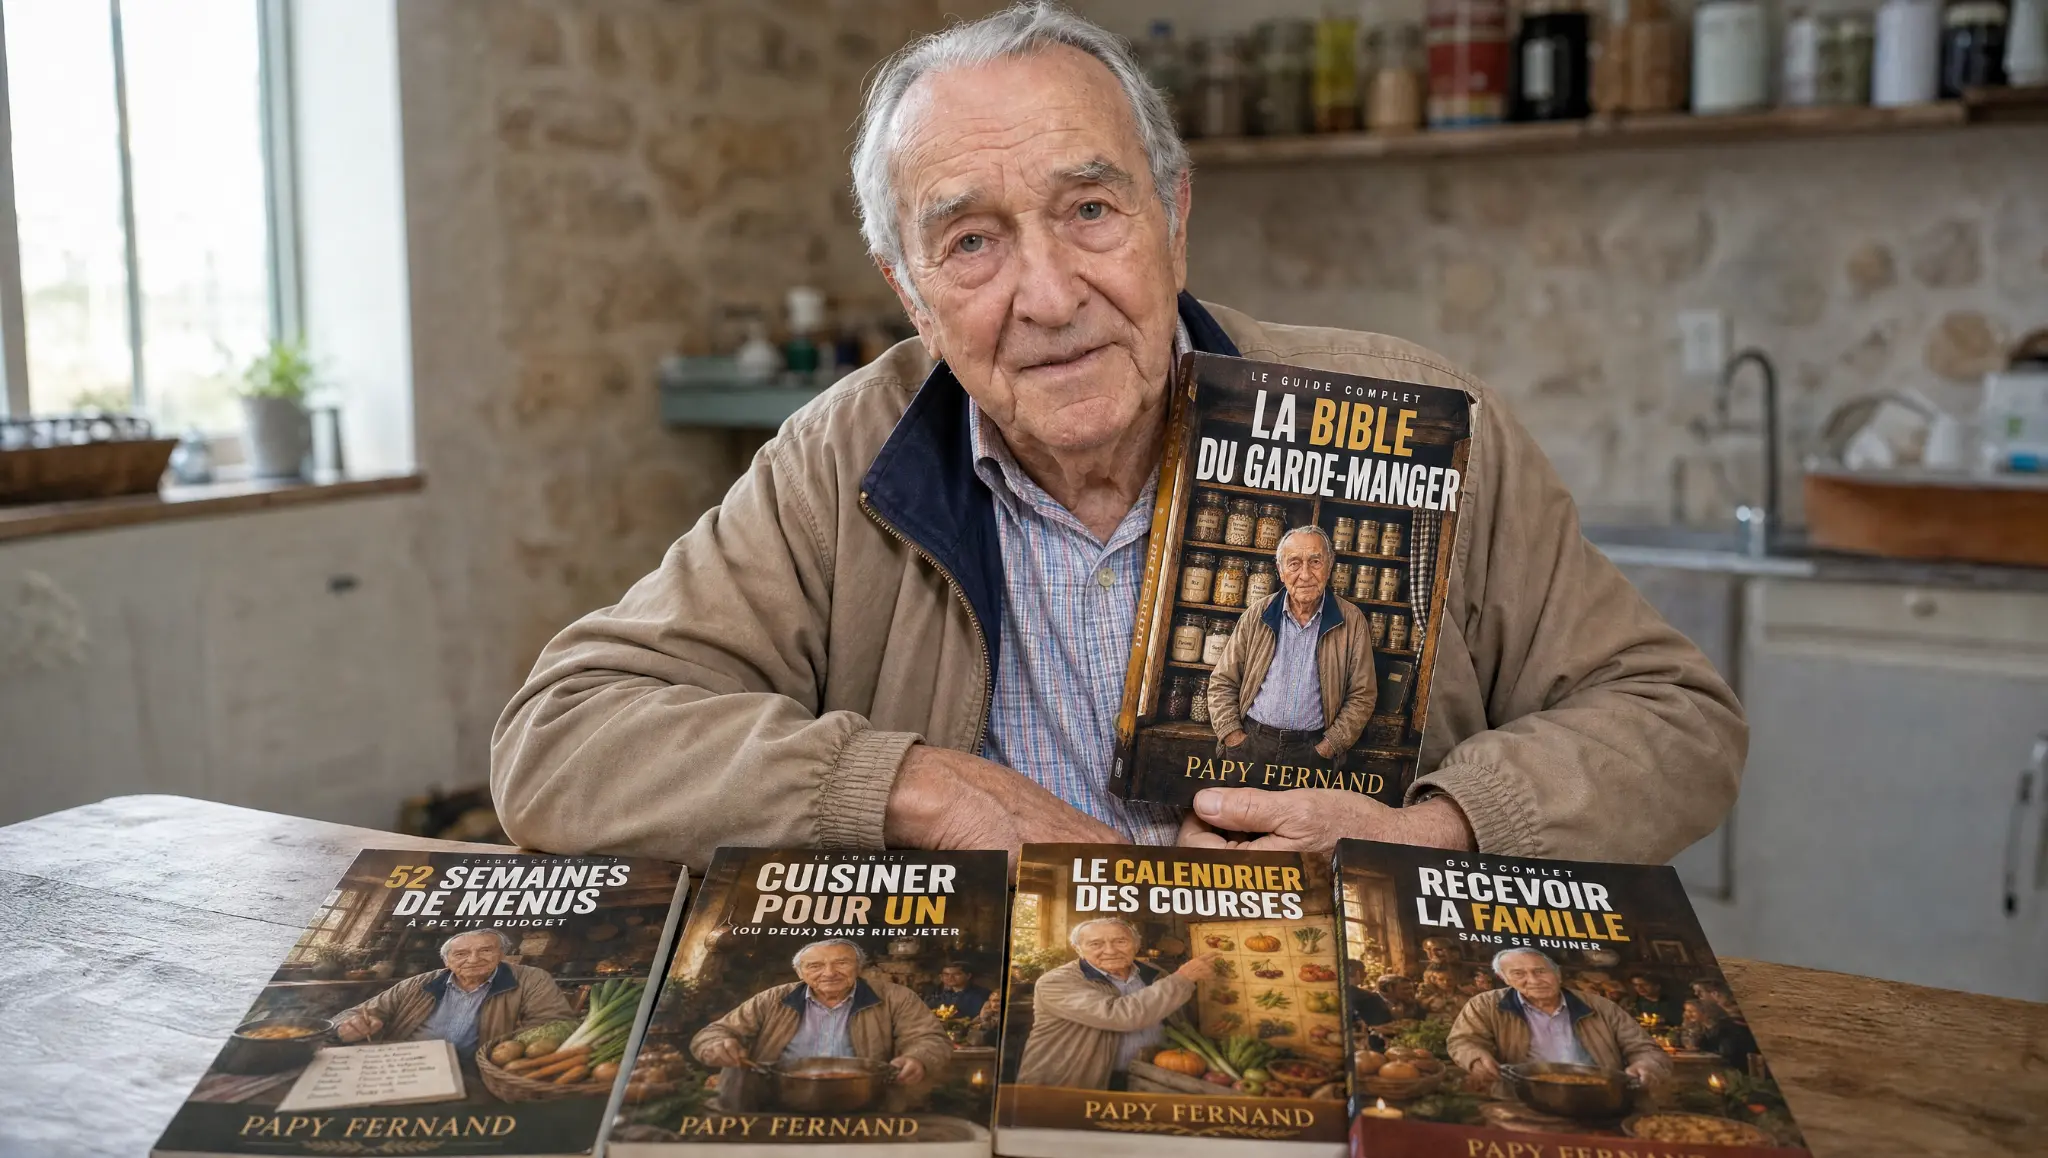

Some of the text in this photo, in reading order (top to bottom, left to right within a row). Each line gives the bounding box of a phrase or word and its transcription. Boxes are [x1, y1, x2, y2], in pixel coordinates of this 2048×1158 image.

[1251, 371, 1421, 404] LE GUIDE COMPLET
[1251, 389, 1296, 443] LA
[1309, 397, 1418, 457] BIBLE
[1196, 436, 1461, 512] DU GARDE-MANGER
[1184, 755, 1384, 795] PAPY FERNAND
[384, 864, 631, 889] 52 SEMAINES
[755, 862, 957, 894] CUISINER
[1072, 857, 1108, 883] LE
[1115, 858, 1304, 891] CALENDRIER
[1499, 864, 1573, 878] COMLET
[392, 888, 600, 916] DE MENUS
[1075, 884, 1304, 920] DES COURSES
[1418, 866, 1613, 911] RECEVOIR
[425, 919, 485, 927] PETIT
[493, 918, 567, 927] BUDGET
[751, 894, 946, 925] POUR UN
[1416, 897, 1631, 942] LA FAMILLE
[732, 926, 960, 938] (OU DEUX) SANS RIEN JETER
[1459, 931, 1602, 951] SANS SE RUINER
[238, 1115, 517, 1138] PAPY FERNAND
[679, 1115, 919, 1137] PAPY FERNAND
[1084, 1100, 1315, 1128] PAPY FERNAND
[1467, 1138, 1545, 1158] PAPY
